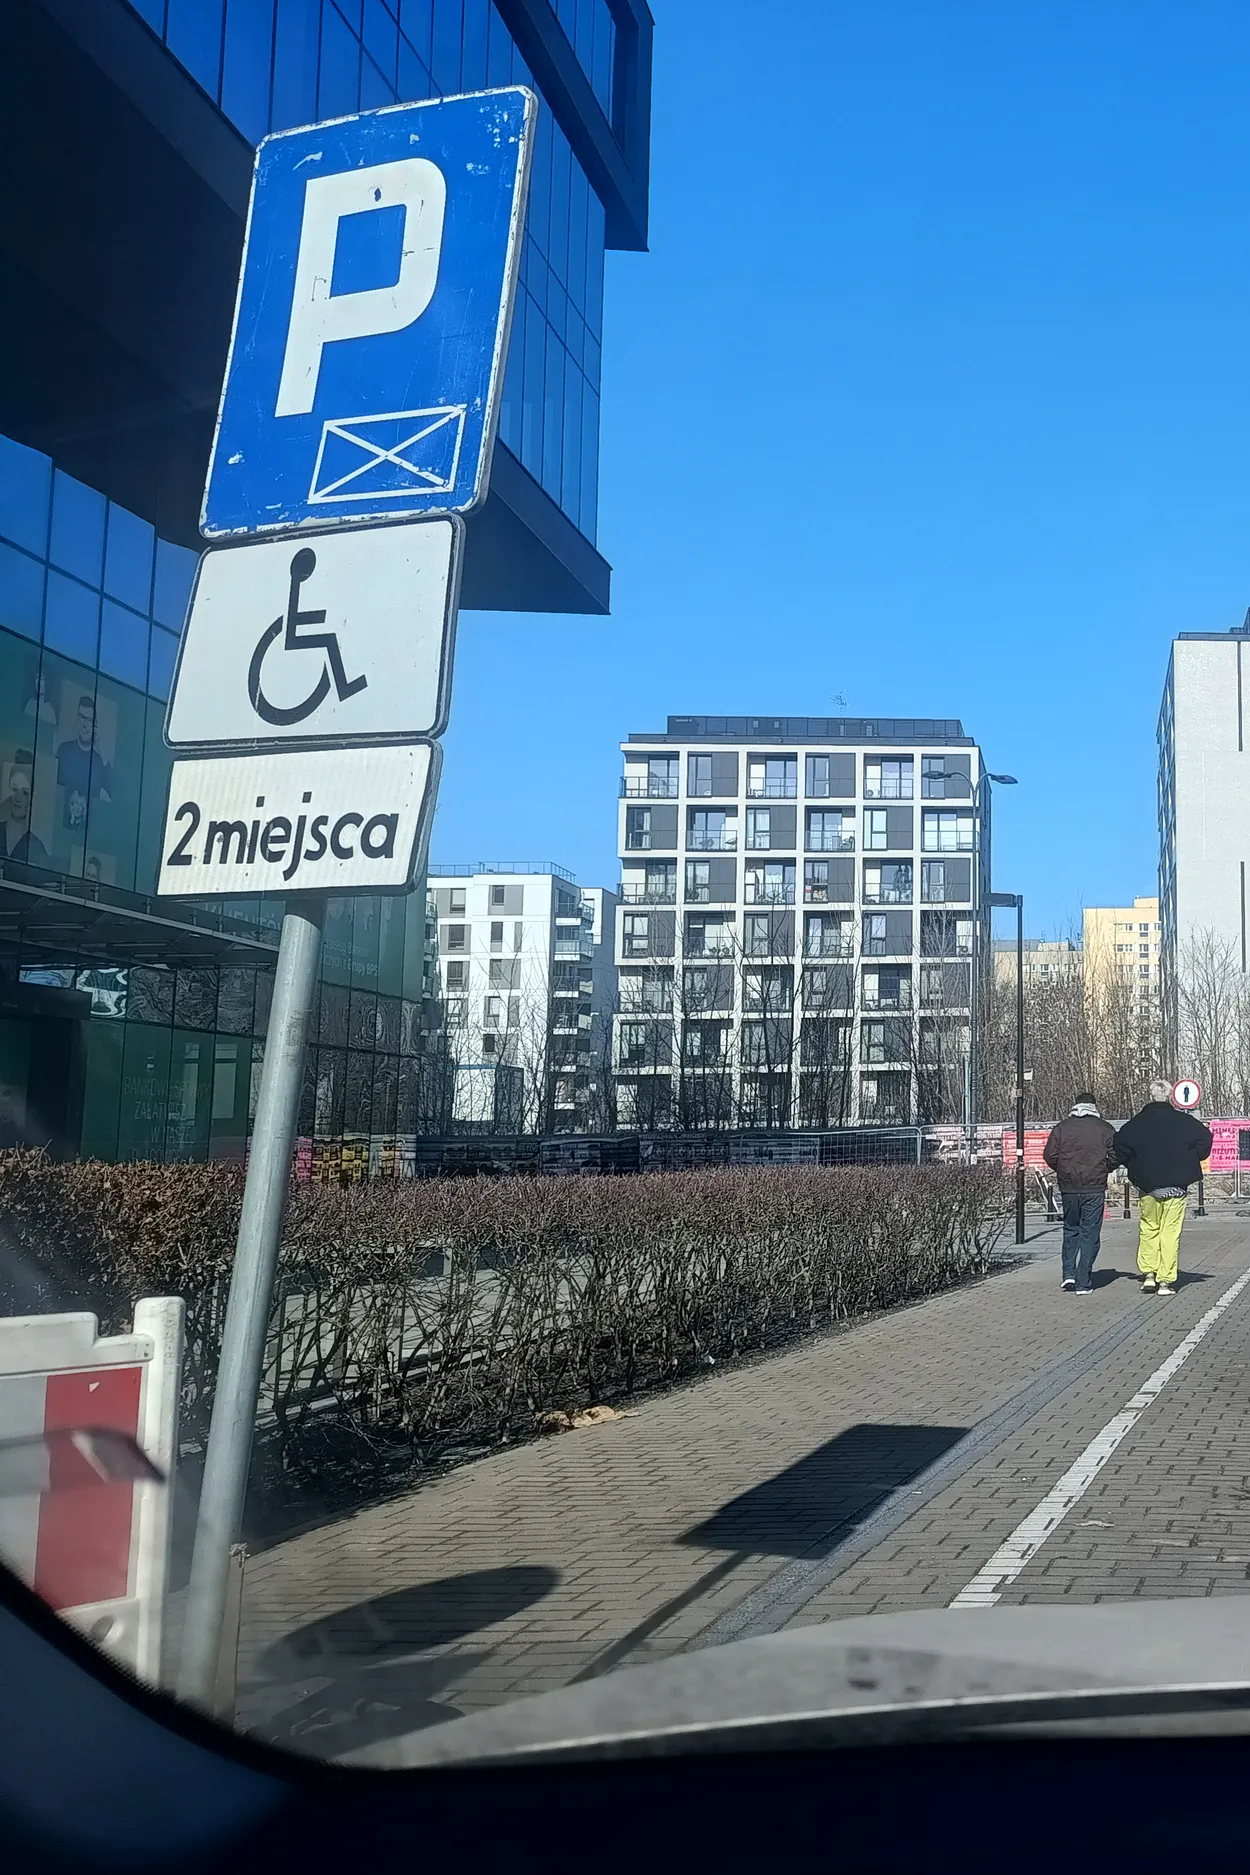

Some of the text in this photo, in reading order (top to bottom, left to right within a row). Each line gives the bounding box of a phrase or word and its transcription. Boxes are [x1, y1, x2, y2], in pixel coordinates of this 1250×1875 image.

[274, 157, 447, 418] P
[167, 791, 399, 881] 2 miejsca
